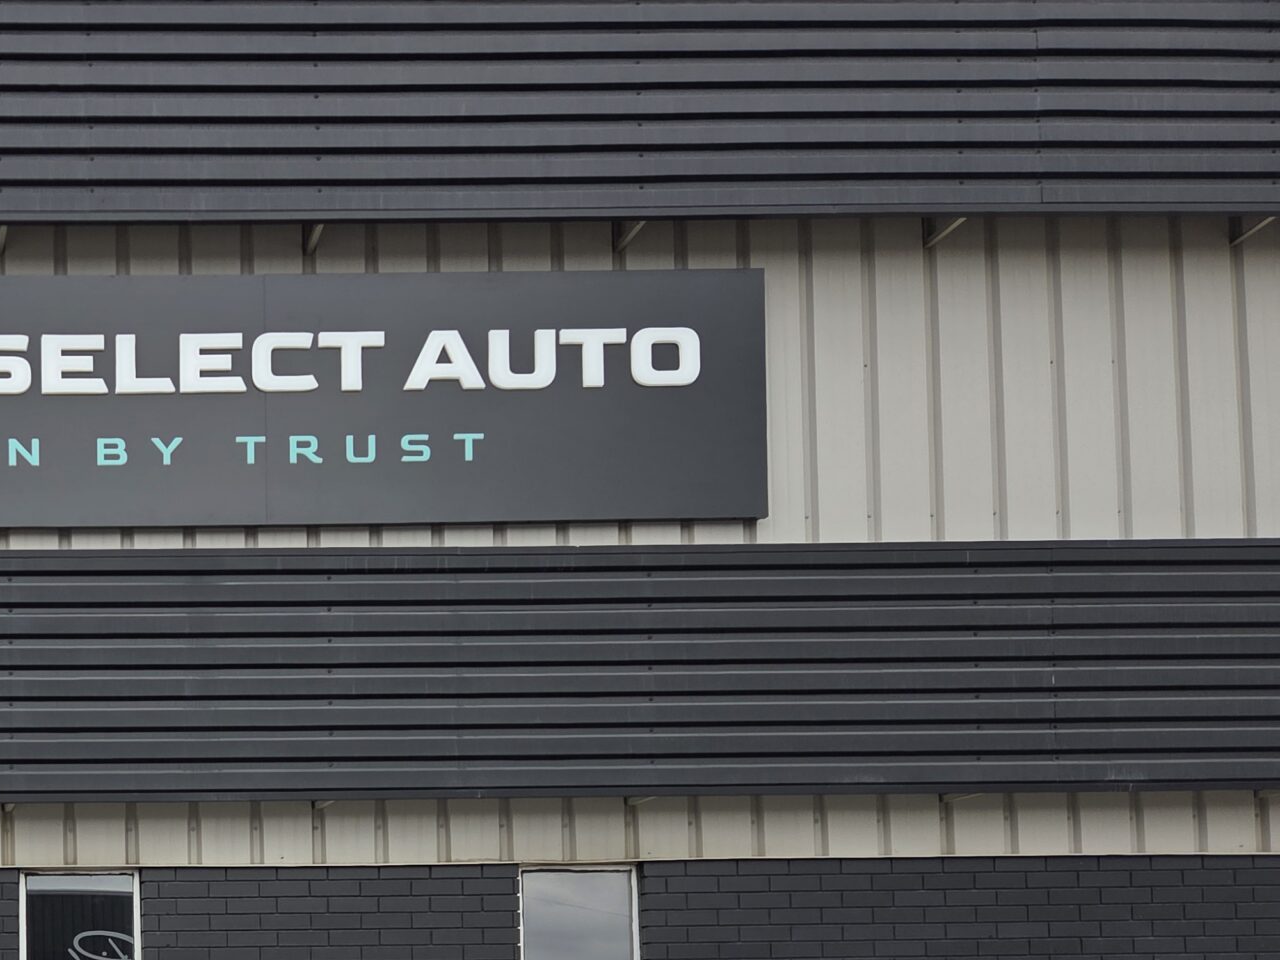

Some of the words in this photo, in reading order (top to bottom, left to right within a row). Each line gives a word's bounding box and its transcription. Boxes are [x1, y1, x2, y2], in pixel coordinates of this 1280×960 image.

[403, 327, 700, 390] AUTO
[97, 437, 183, 466] BY
[236, 433, 484, 464] TRUST
